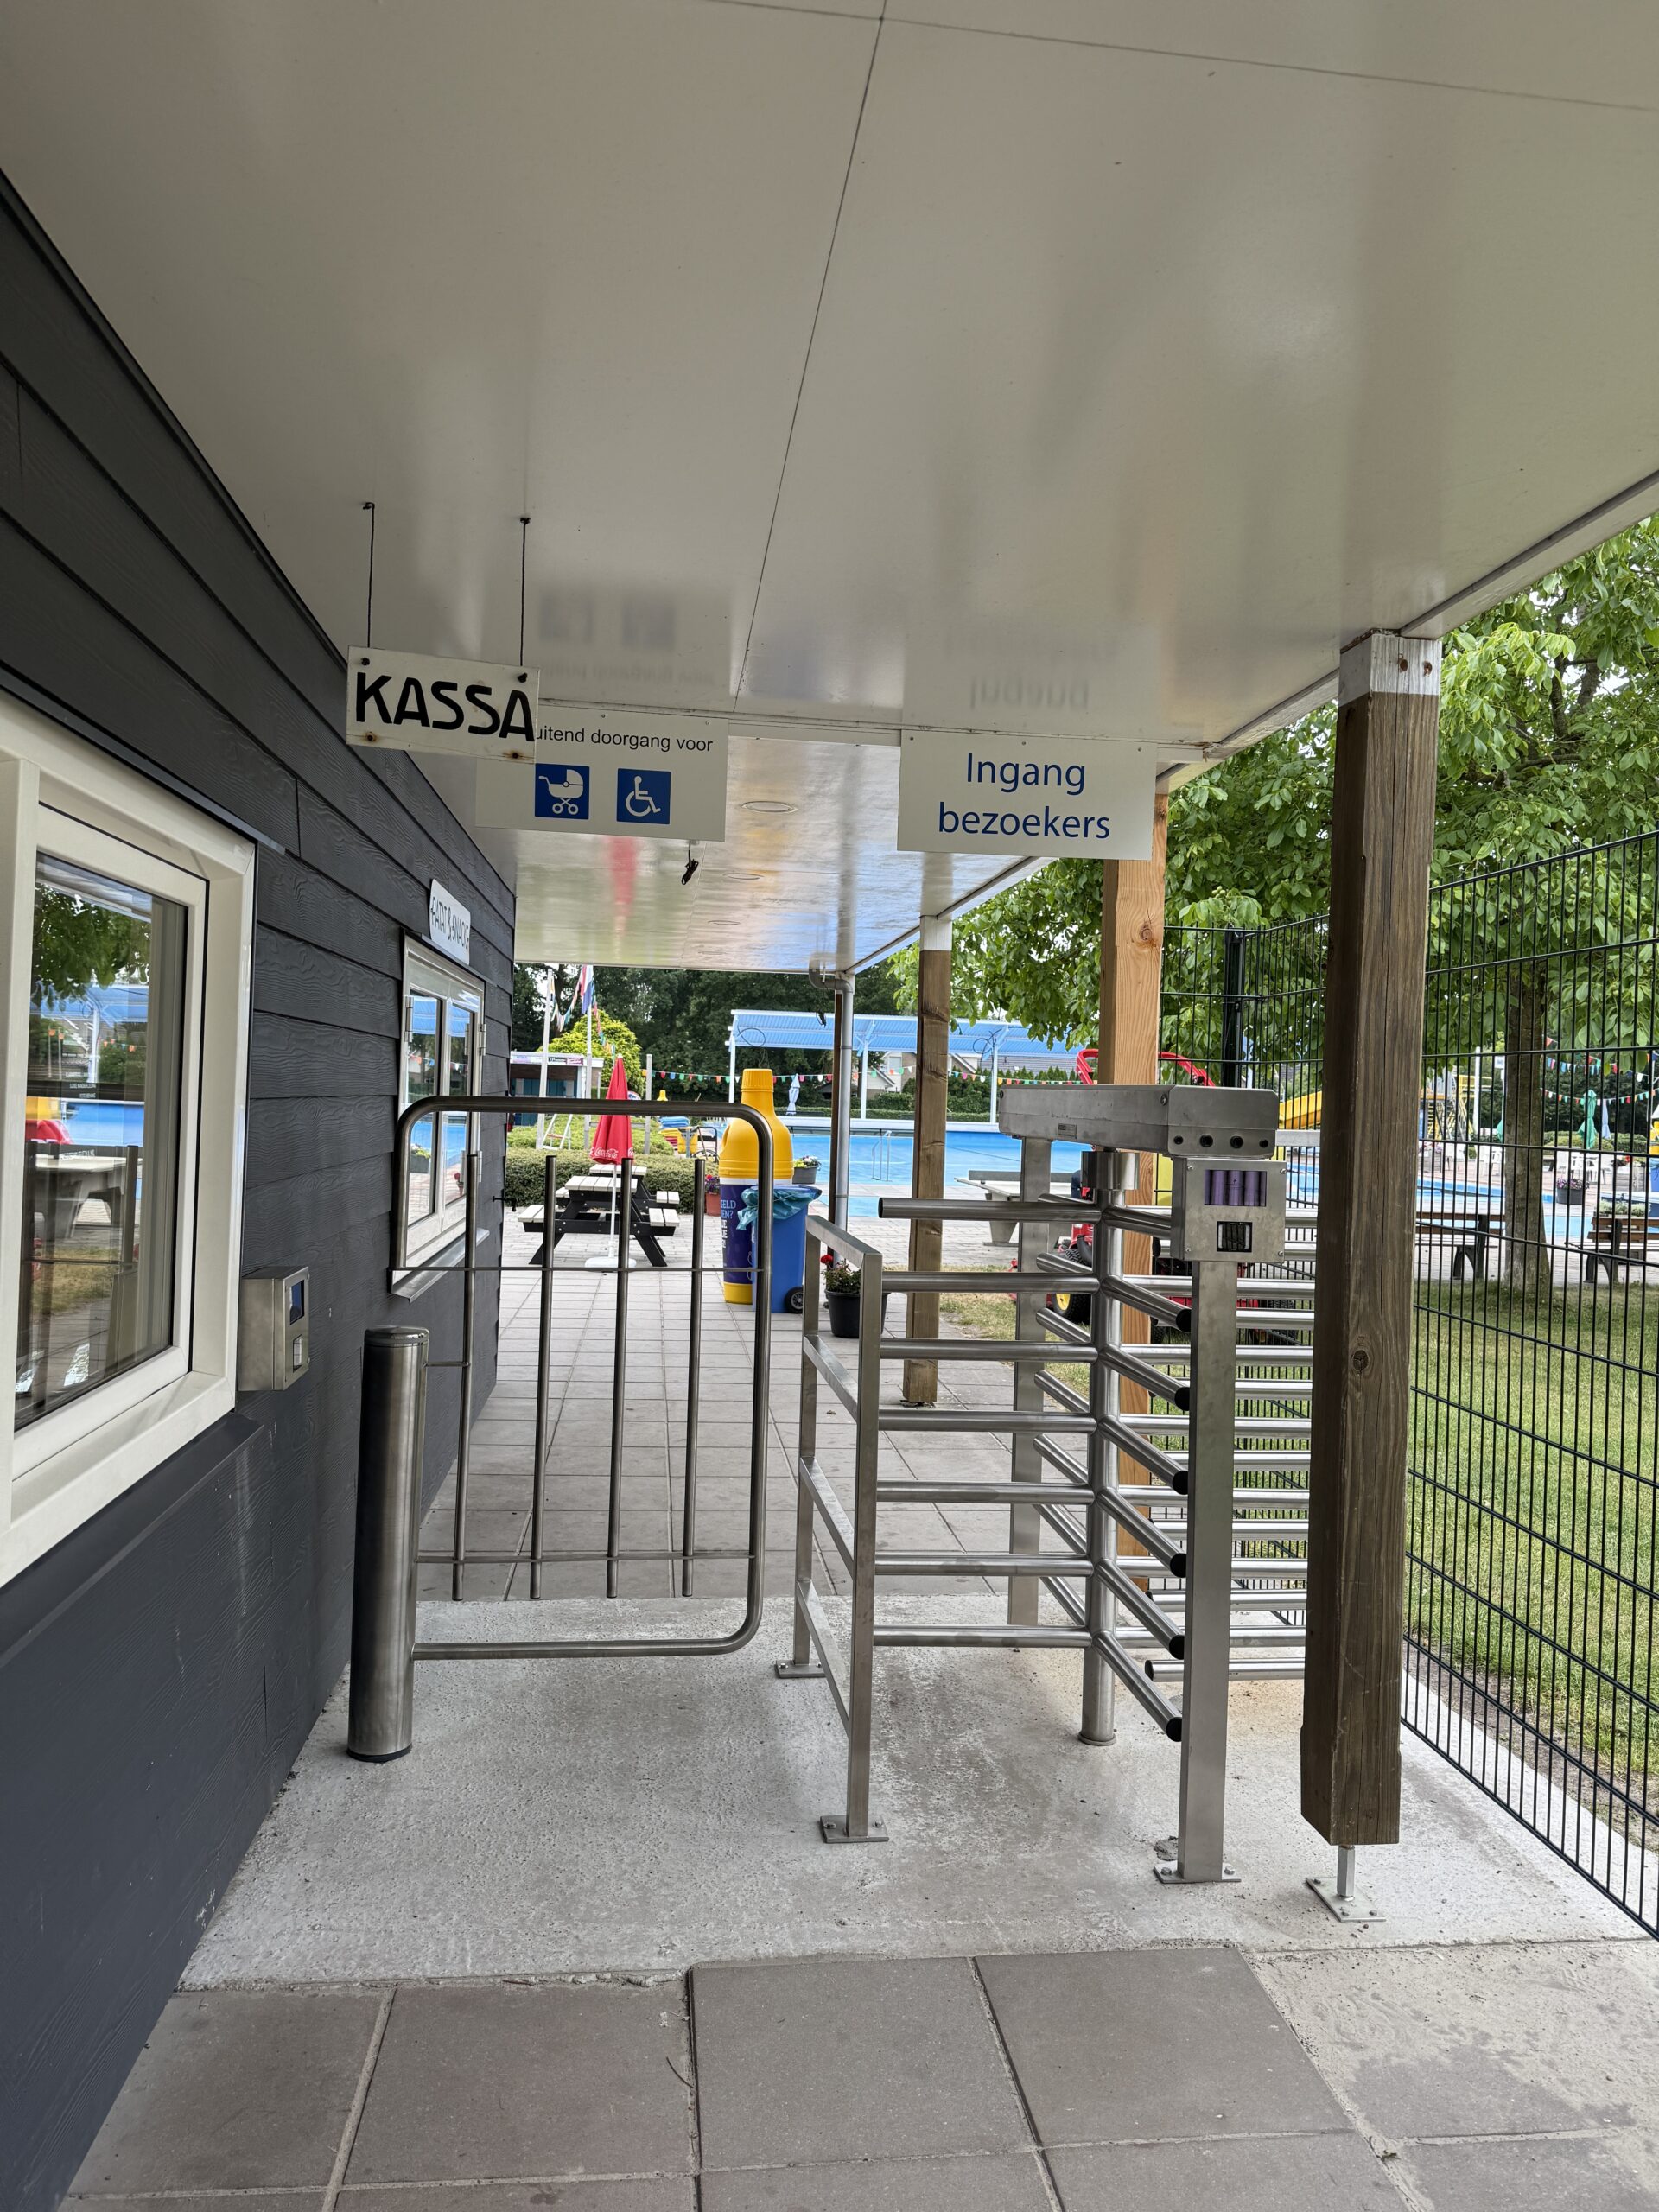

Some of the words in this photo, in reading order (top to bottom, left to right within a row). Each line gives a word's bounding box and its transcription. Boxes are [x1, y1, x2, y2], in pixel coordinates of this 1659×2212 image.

[356, 671, 535, 742] KASSA
[591, 729, 671, 752] doorgang
[677, 739, 713, 751] voor
[967, 753, 1085, 796] Ingang
[938, 802, 1110, 839] bezoekers
[430, 896, 447, 933] PATAT
